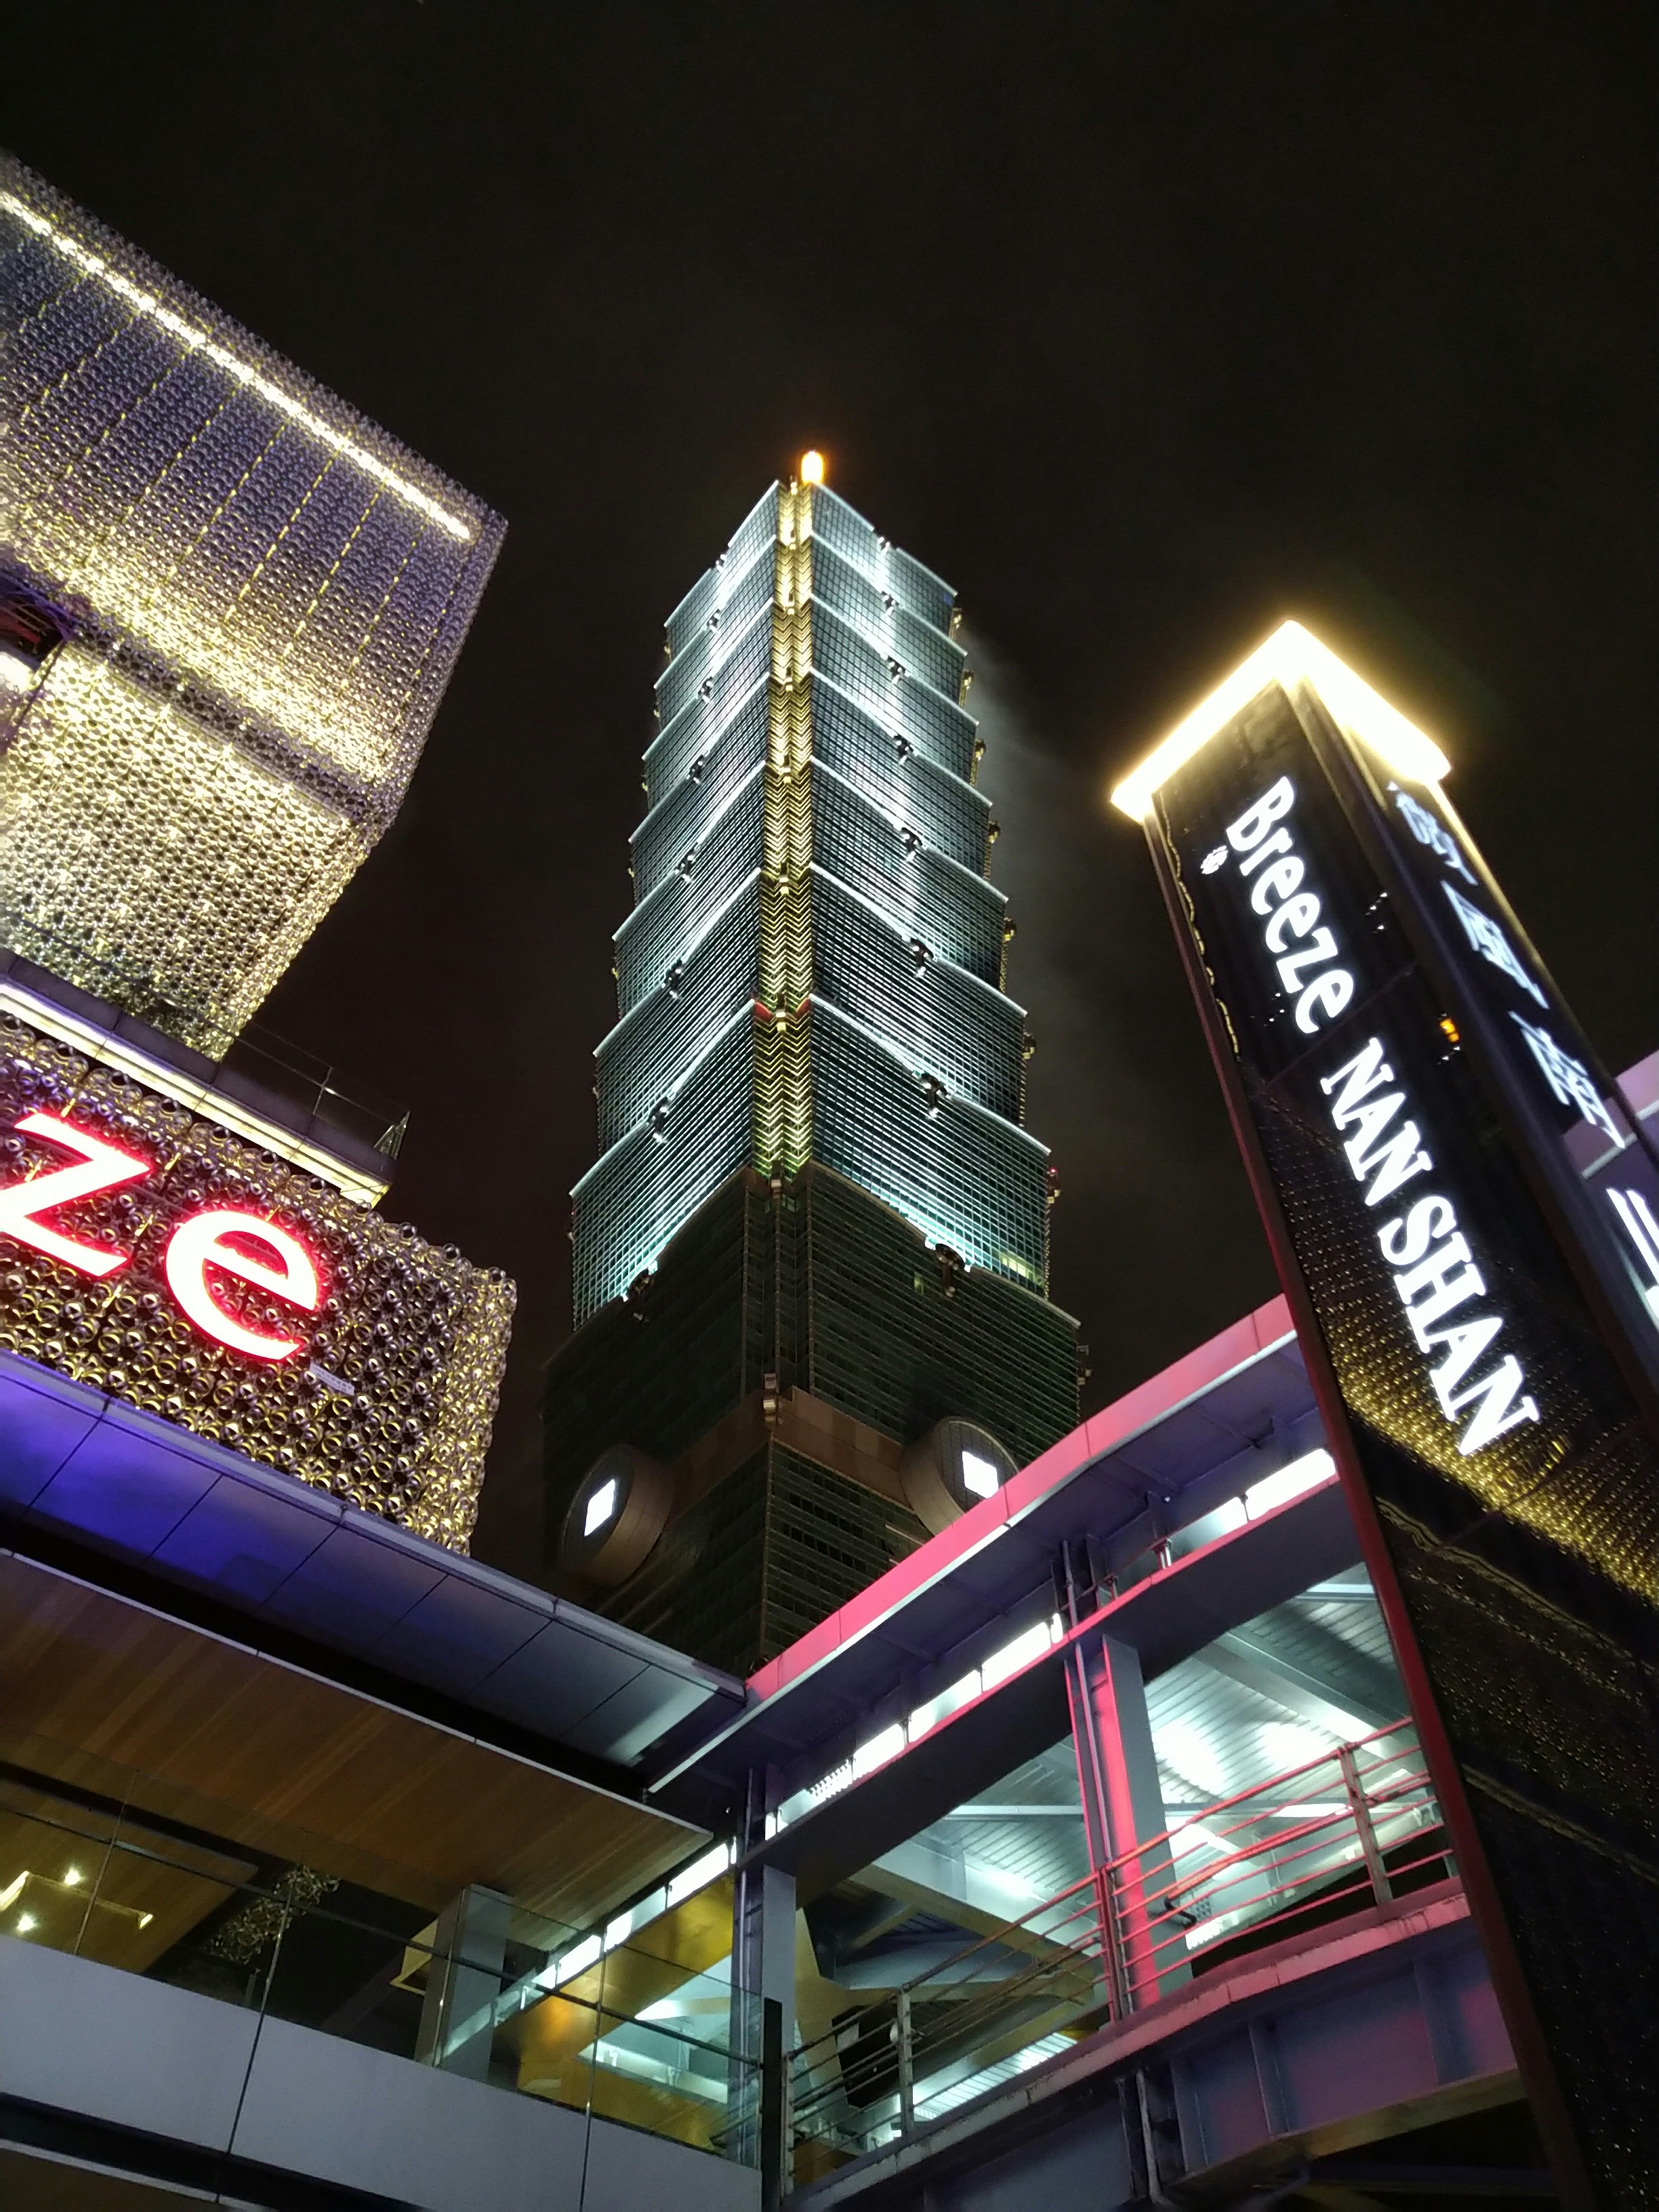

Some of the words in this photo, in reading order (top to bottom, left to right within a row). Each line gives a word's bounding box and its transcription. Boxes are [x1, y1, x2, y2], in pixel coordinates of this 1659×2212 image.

[0, 1111, 319, 1360] ze
[1225, 775, 1354, 1034] Breeze
[1319, 1037, 1433, 1207] NAN
[1376, 1195, 1540, 1457] SHAN
